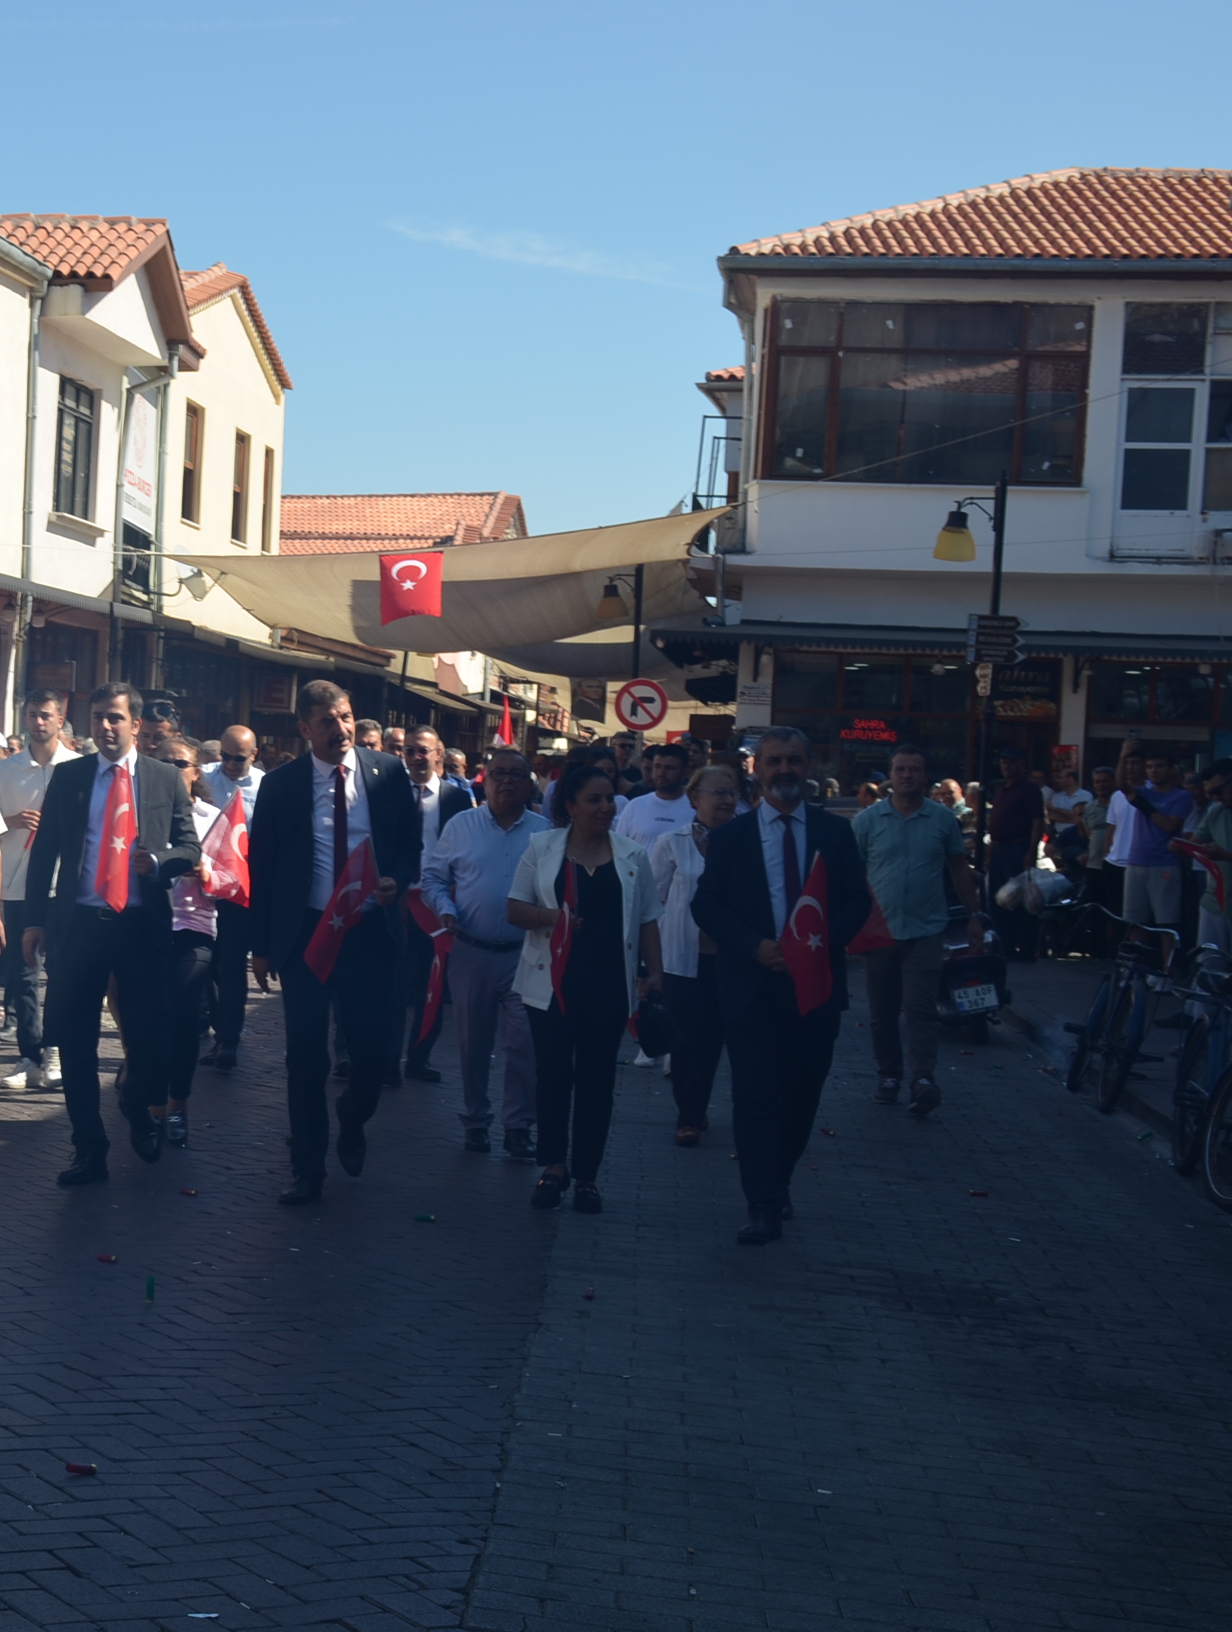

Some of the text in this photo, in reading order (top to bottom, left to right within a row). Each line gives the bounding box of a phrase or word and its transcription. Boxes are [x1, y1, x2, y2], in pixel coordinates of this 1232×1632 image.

[997, 665, 1052, 683] ahra
[852, 718, 887, 730] SAHRA
[840, 727, 898, 742] KURUYEMİŞ
[957, 990, 970, 999] 45
[967, 997, 985, 1008] 367
